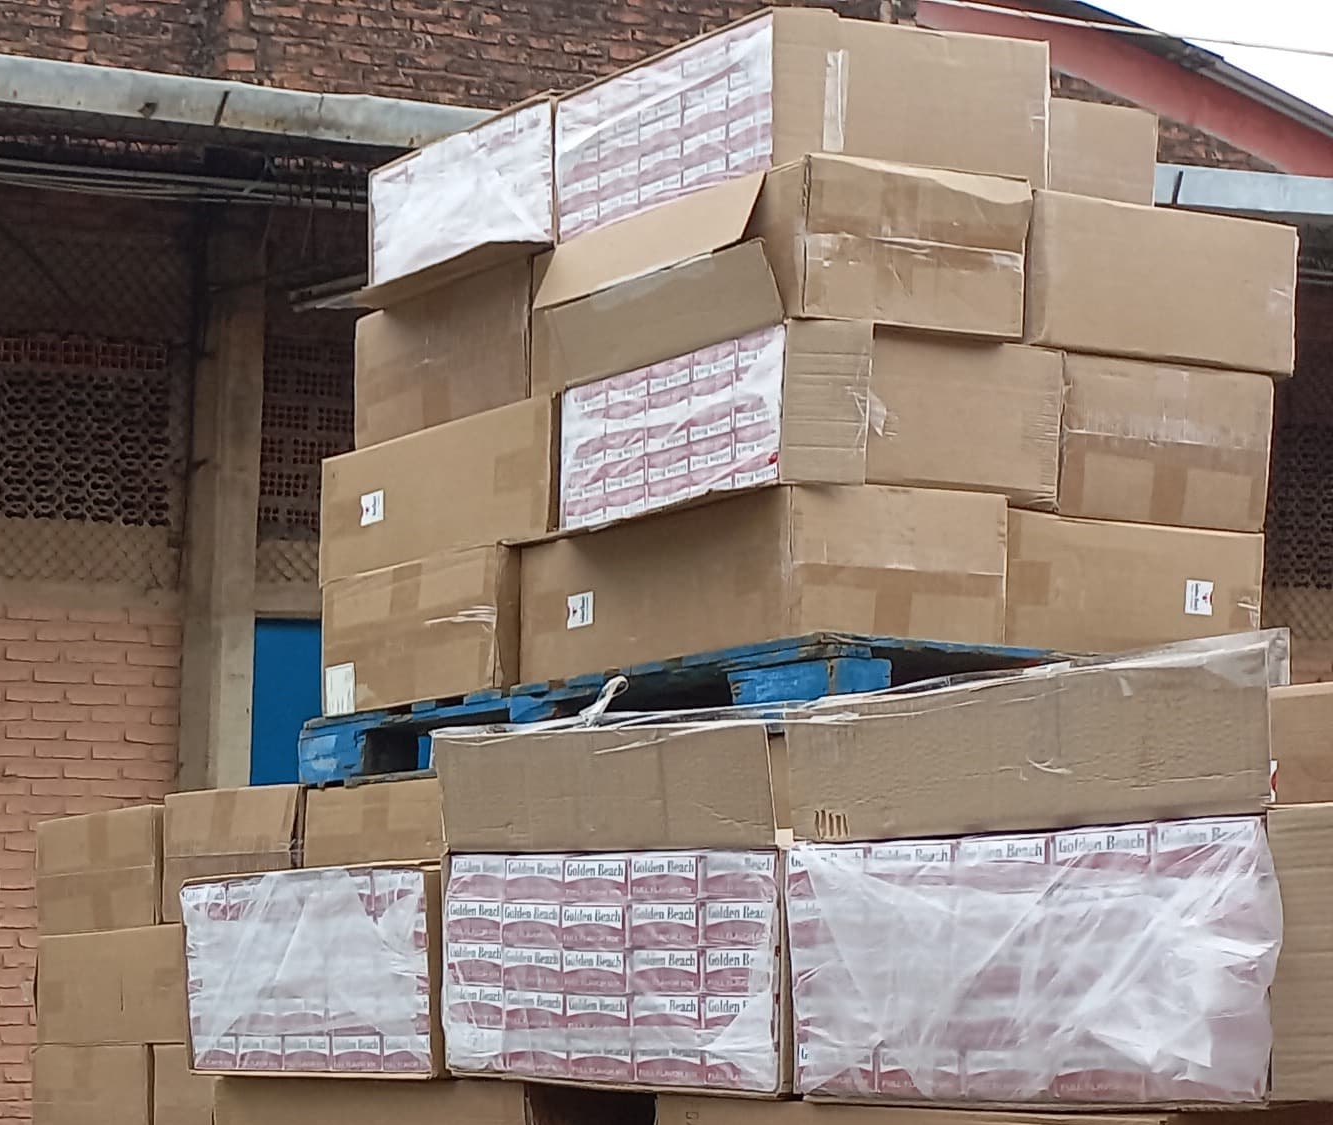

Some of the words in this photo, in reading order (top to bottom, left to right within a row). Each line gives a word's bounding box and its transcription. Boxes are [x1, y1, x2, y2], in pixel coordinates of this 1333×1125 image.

[1106, 834, 1146, 850] Beach
[567, 863, 596, 877] Golden
[598, 863, 624, 877] Beach
[633, 860, 665, 874] Golden
[667, 859, 695, 873] Beach
[450, 903, 476, 916] Golden
[478, 903, 501, 917] Beach
[504, 907, 532, 920] Golden
[533, 907, 558, 921] Beach
[563, 909, 593, 922] Golden
[595, 909, 621, 923] Beach
[634, 906, 665, 920] Golden
[667, 906, 695, 921] Beach
[708, 905, 741, 919] Golden
[478, 945, 502, 959] Beach
[534, 951, 559, 965] Beach
[565, 954, 594, 968] Golden
[596, 954, 622, 968] Beach
[668, 952, 696, 967] Beach
[708, 952, 740, 967] Golden
[479, 988, 503, 1001] Beach
[536, 995, 561, 1009] Beach
[669, 999, 697, 1013] Beach
[708, 999, 740, 1013] Golden
